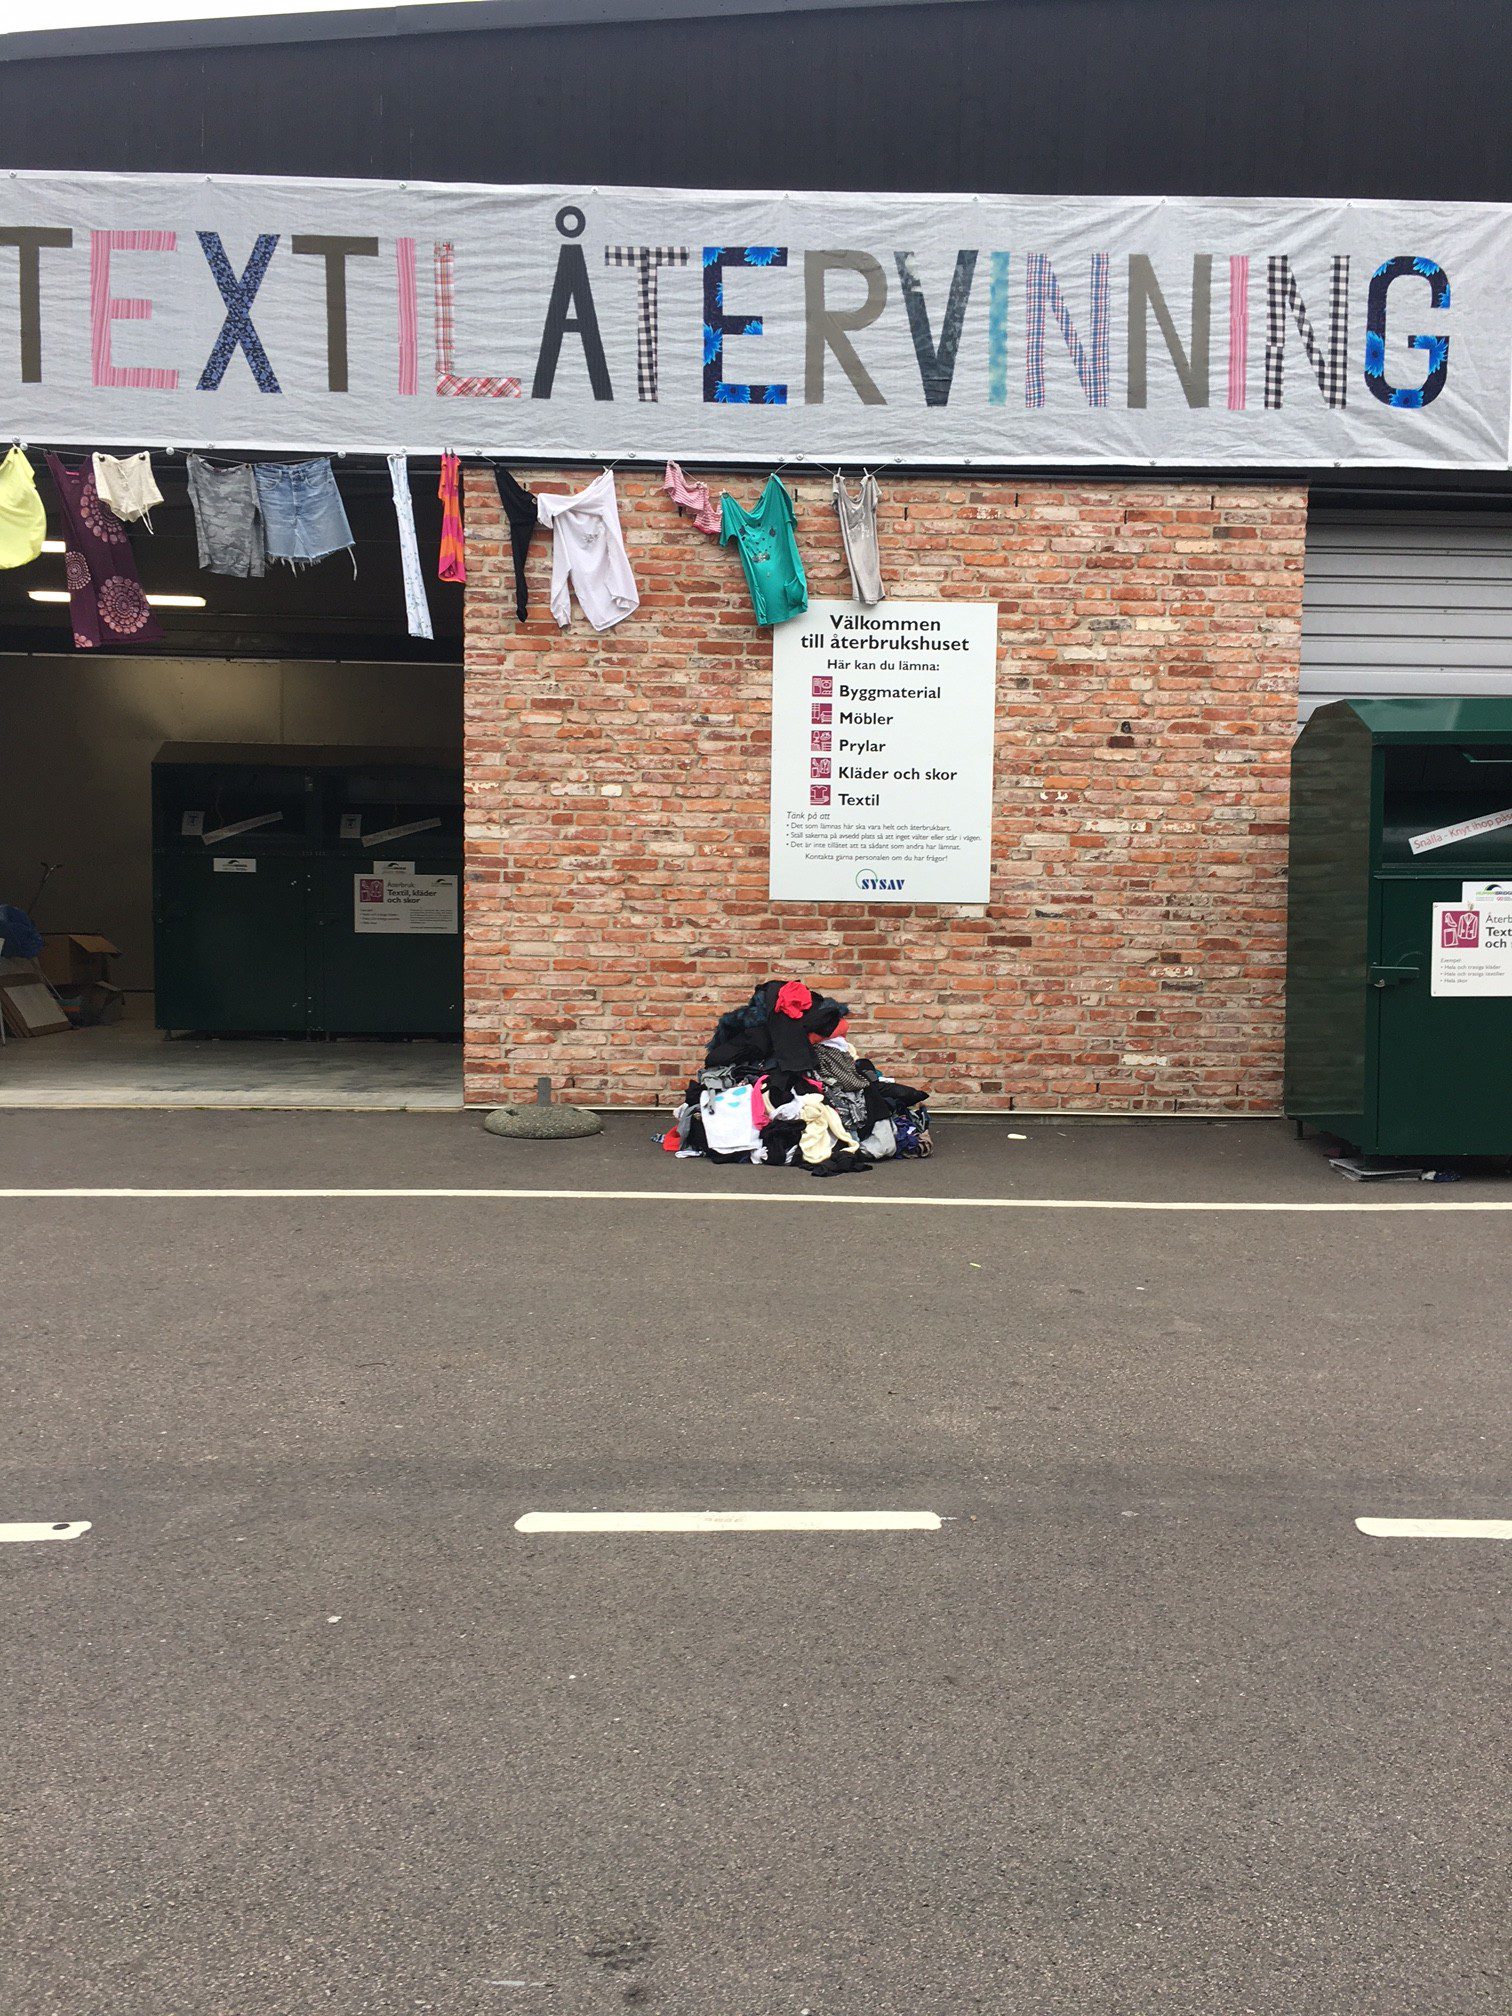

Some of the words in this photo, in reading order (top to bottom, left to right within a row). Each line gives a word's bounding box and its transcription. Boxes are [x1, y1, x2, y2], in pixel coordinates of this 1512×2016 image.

[0, 206, 1452, 410] TEXTILÅTERVINNING
[830, 615, 940, 631] Välkommen
[801, 634, 823, 648] till
[831, 634, 969, 650] återbrukshuset
[828, 659, 851, 669] Här
[855, 660, 875, 669] kan
[880, 660, 894, 670] du
[899, 661, 939, 671] lämna:
[840, 685, 940, 701] Byggmaterial
[840, 712, 893, 724] Möbler
[840, 740, 886, 755] Prylar
[839, 767, 889, 779] Kläder
[894, 768, 919, 779] och
[926, 768, 957, 780] skor
[838, 794, 879, 806] Textil
[807, 812, 817, 821] på
[1449, 826, 1470, 837] Knyt
[1472, 820, 1493, 830] ihop
[1495, 813, 1512, 825] pås
[861, 879, 904, 890] SYSAV
[1486, 927, 1512, 937] Text
[1485, 938, 1507, 948] och
